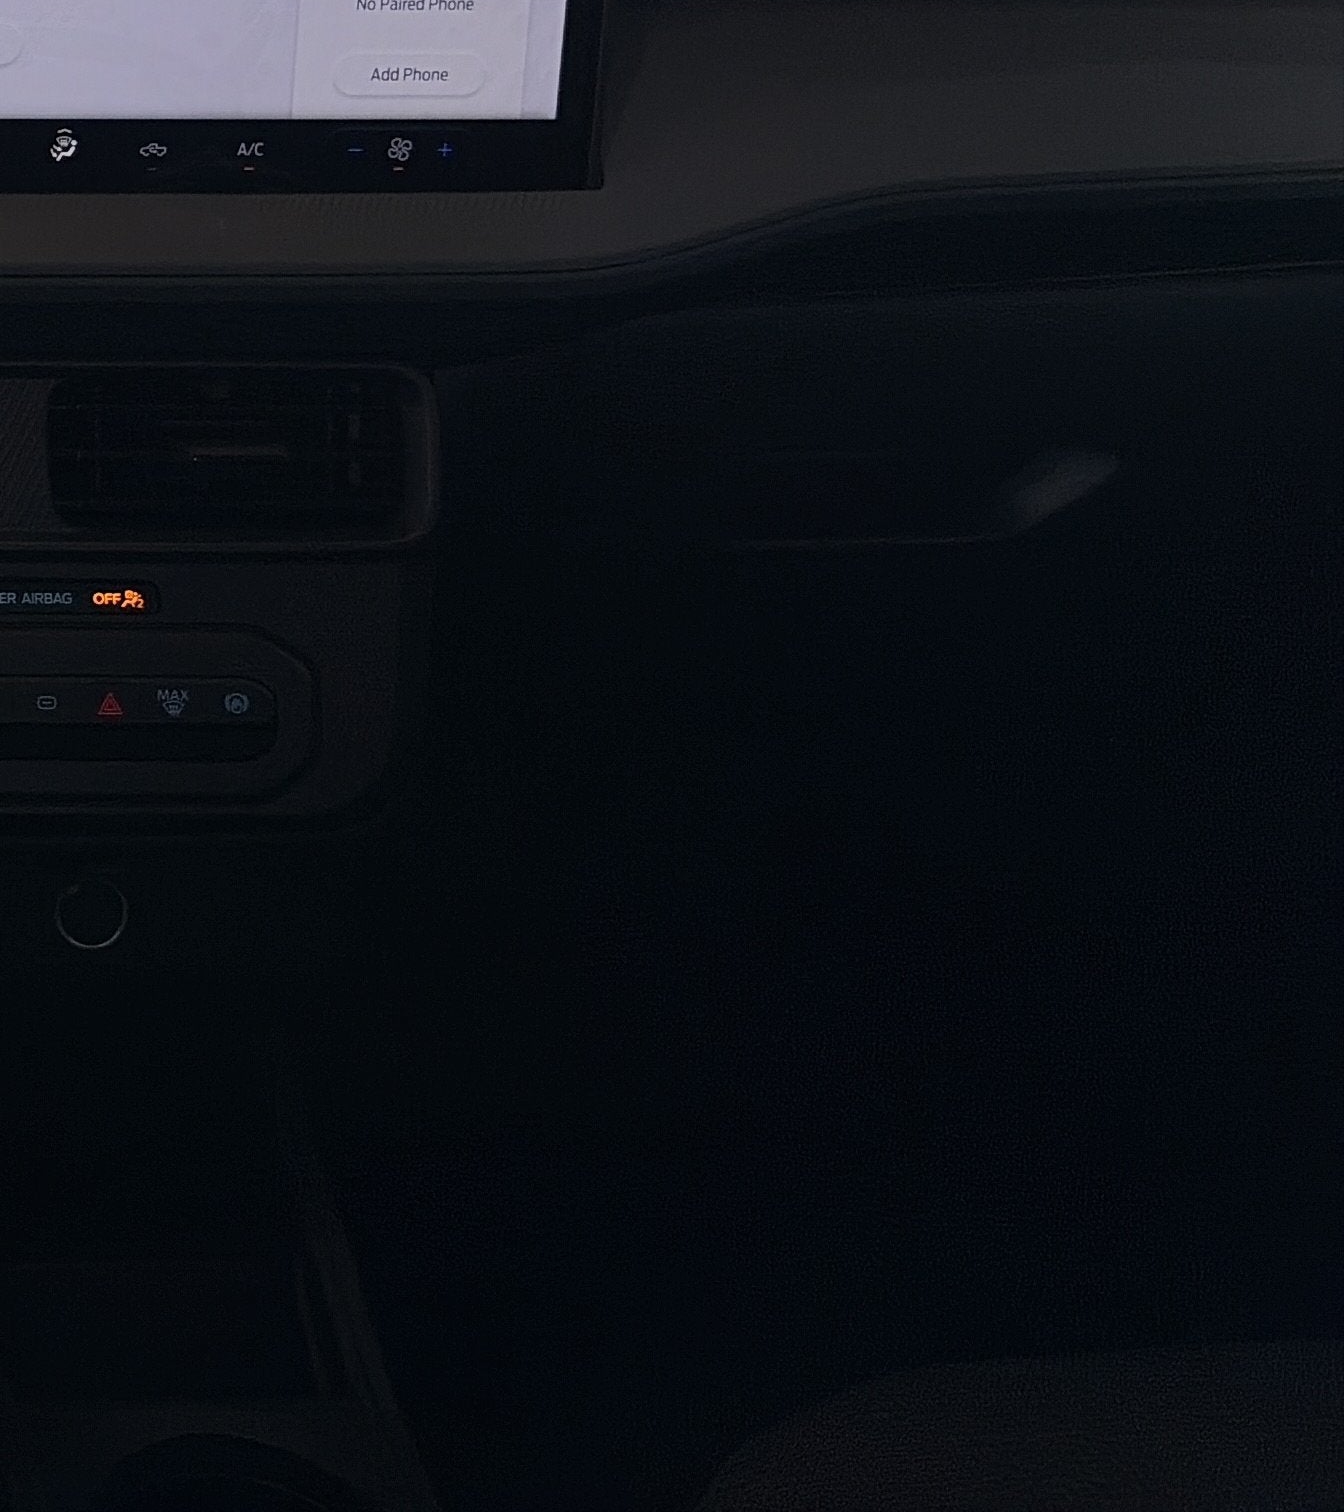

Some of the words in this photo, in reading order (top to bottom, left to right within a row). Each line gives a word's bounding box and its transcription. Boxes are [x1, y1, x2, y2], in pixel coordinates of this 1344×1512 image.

[370, 66, 399, 83] Add
[403, 66, 449, 83] Phone
[236, 142, 265, 158] A/C
[21, 591, 73, 605] AIRBAG
[92, 592, 121, 606] OFF
